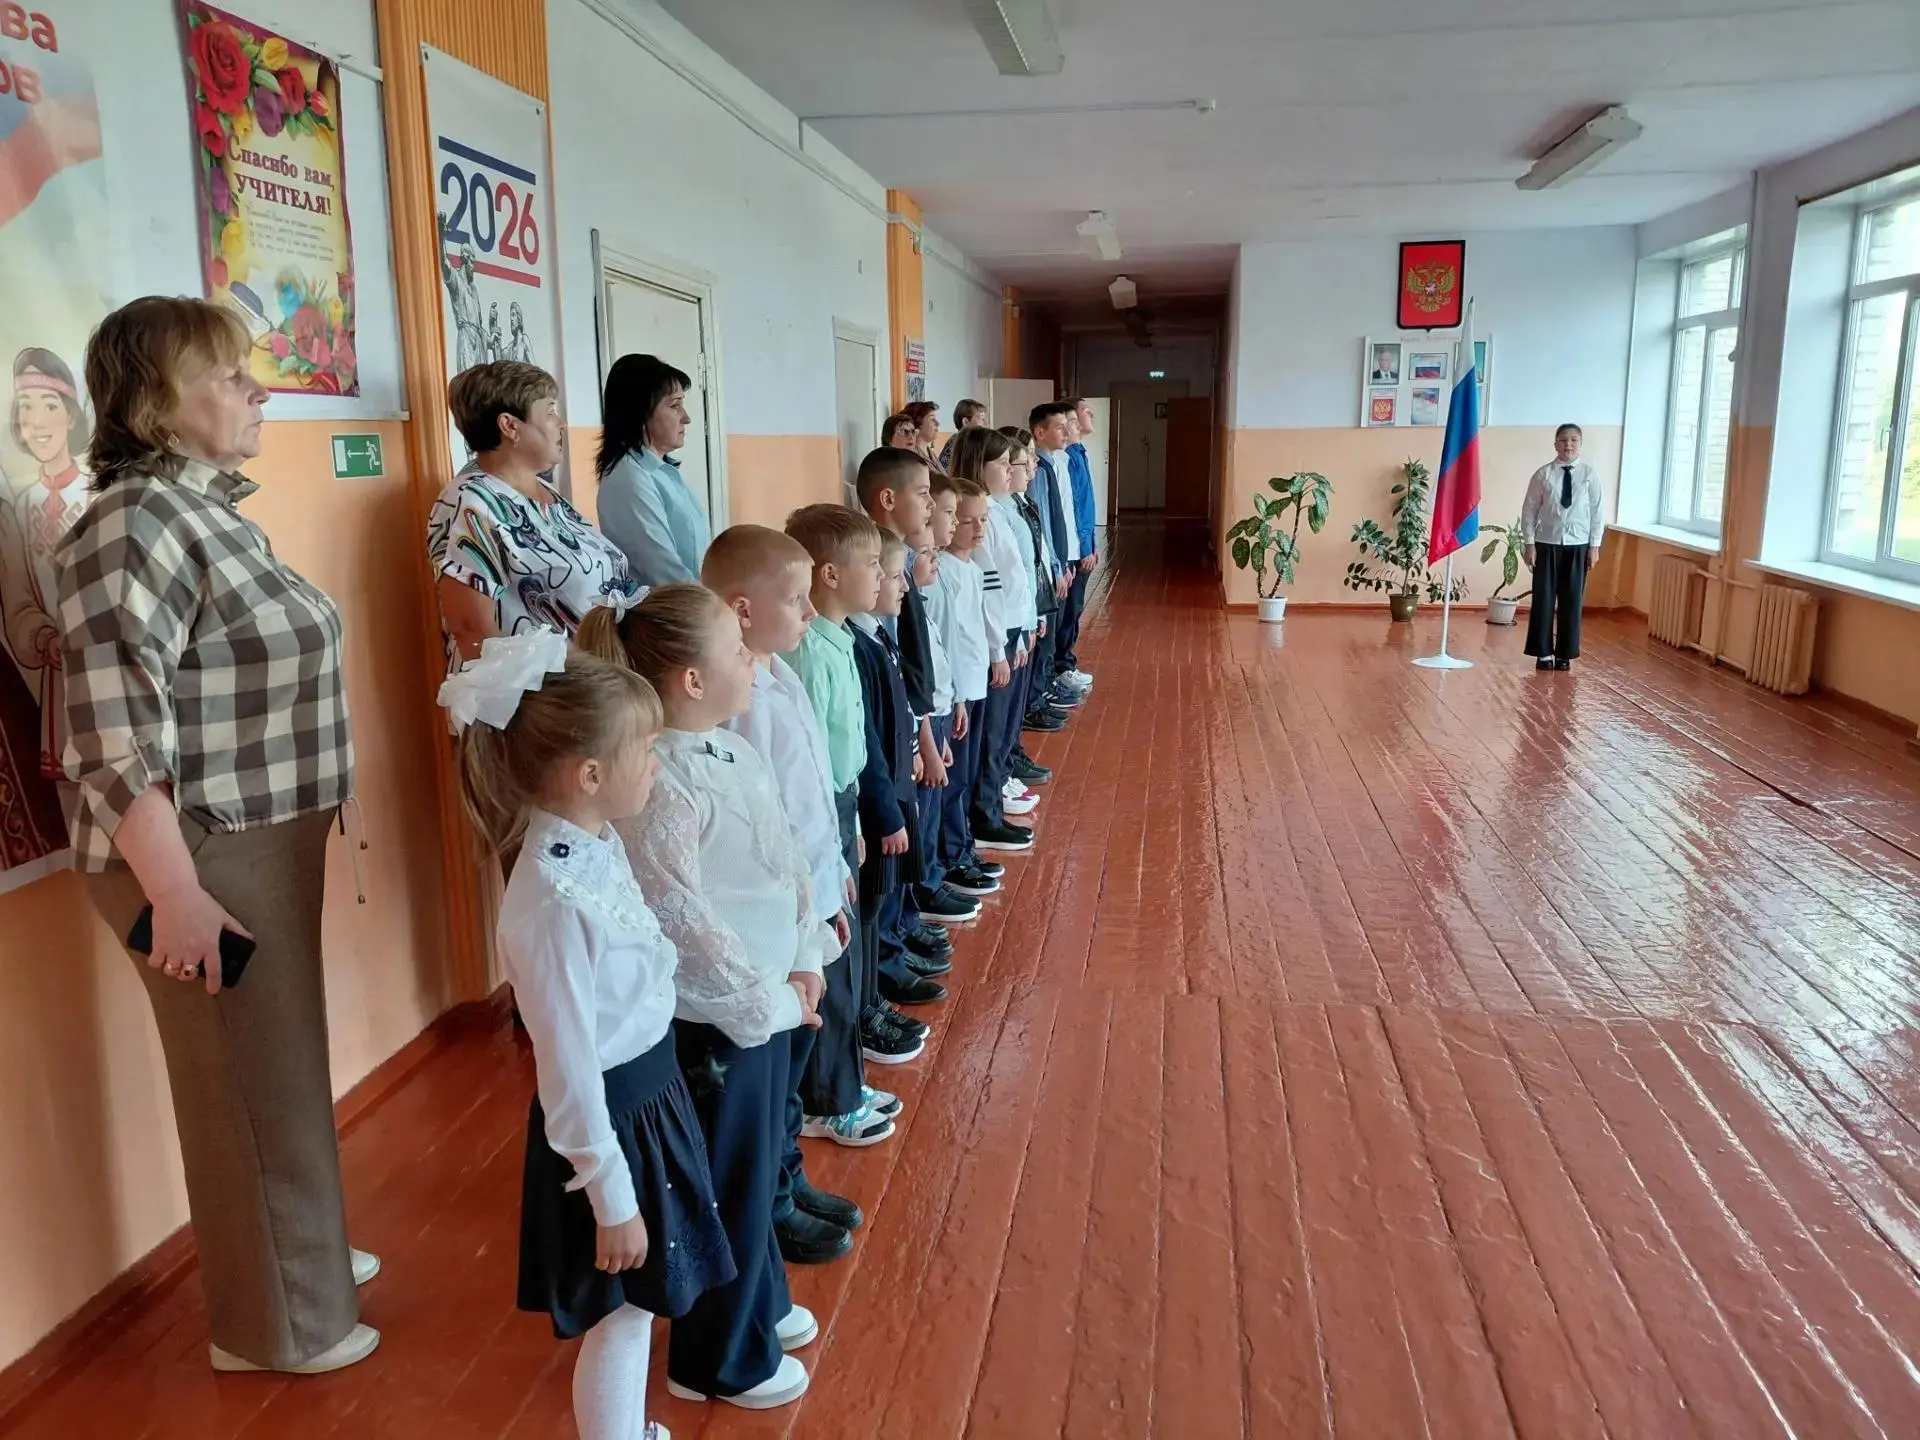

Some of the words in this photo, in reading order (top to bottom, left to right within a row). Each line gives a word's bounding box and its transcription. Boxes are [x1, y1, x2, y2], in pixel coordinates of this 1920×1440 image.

[227, 133, 298, 178] Спасибо
[304, 166, 334, 192] вам,
[233, 172, 332, 216] УЧИТЕЛЯ!
[440, 162, 540, 266] 2026
